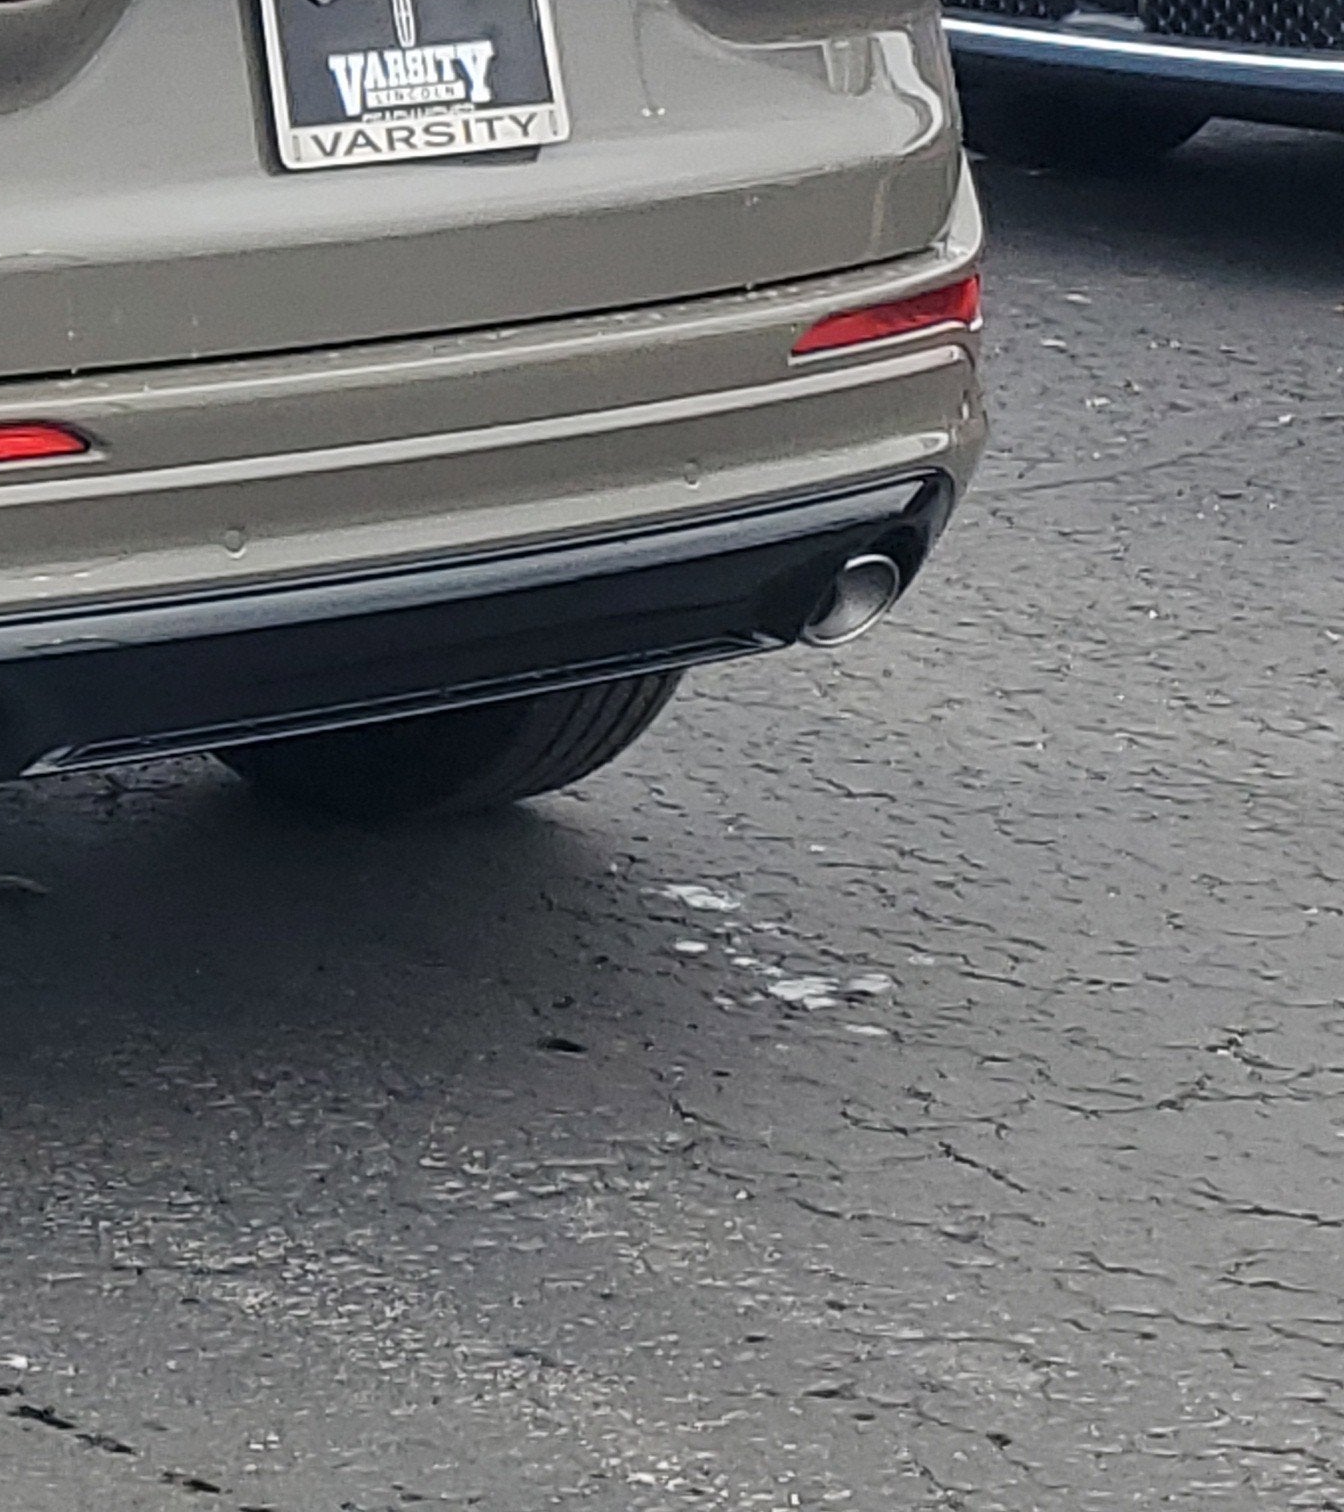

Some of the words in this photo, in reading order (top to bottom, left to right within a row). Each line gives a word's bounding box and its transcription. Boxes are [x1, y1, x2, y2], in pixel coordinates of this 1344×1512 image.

[327, 40, 494, 117] VARSITY
[375, 87, 456, 104] LINCOLN
[311, 112, 538, 158] VARSITY
